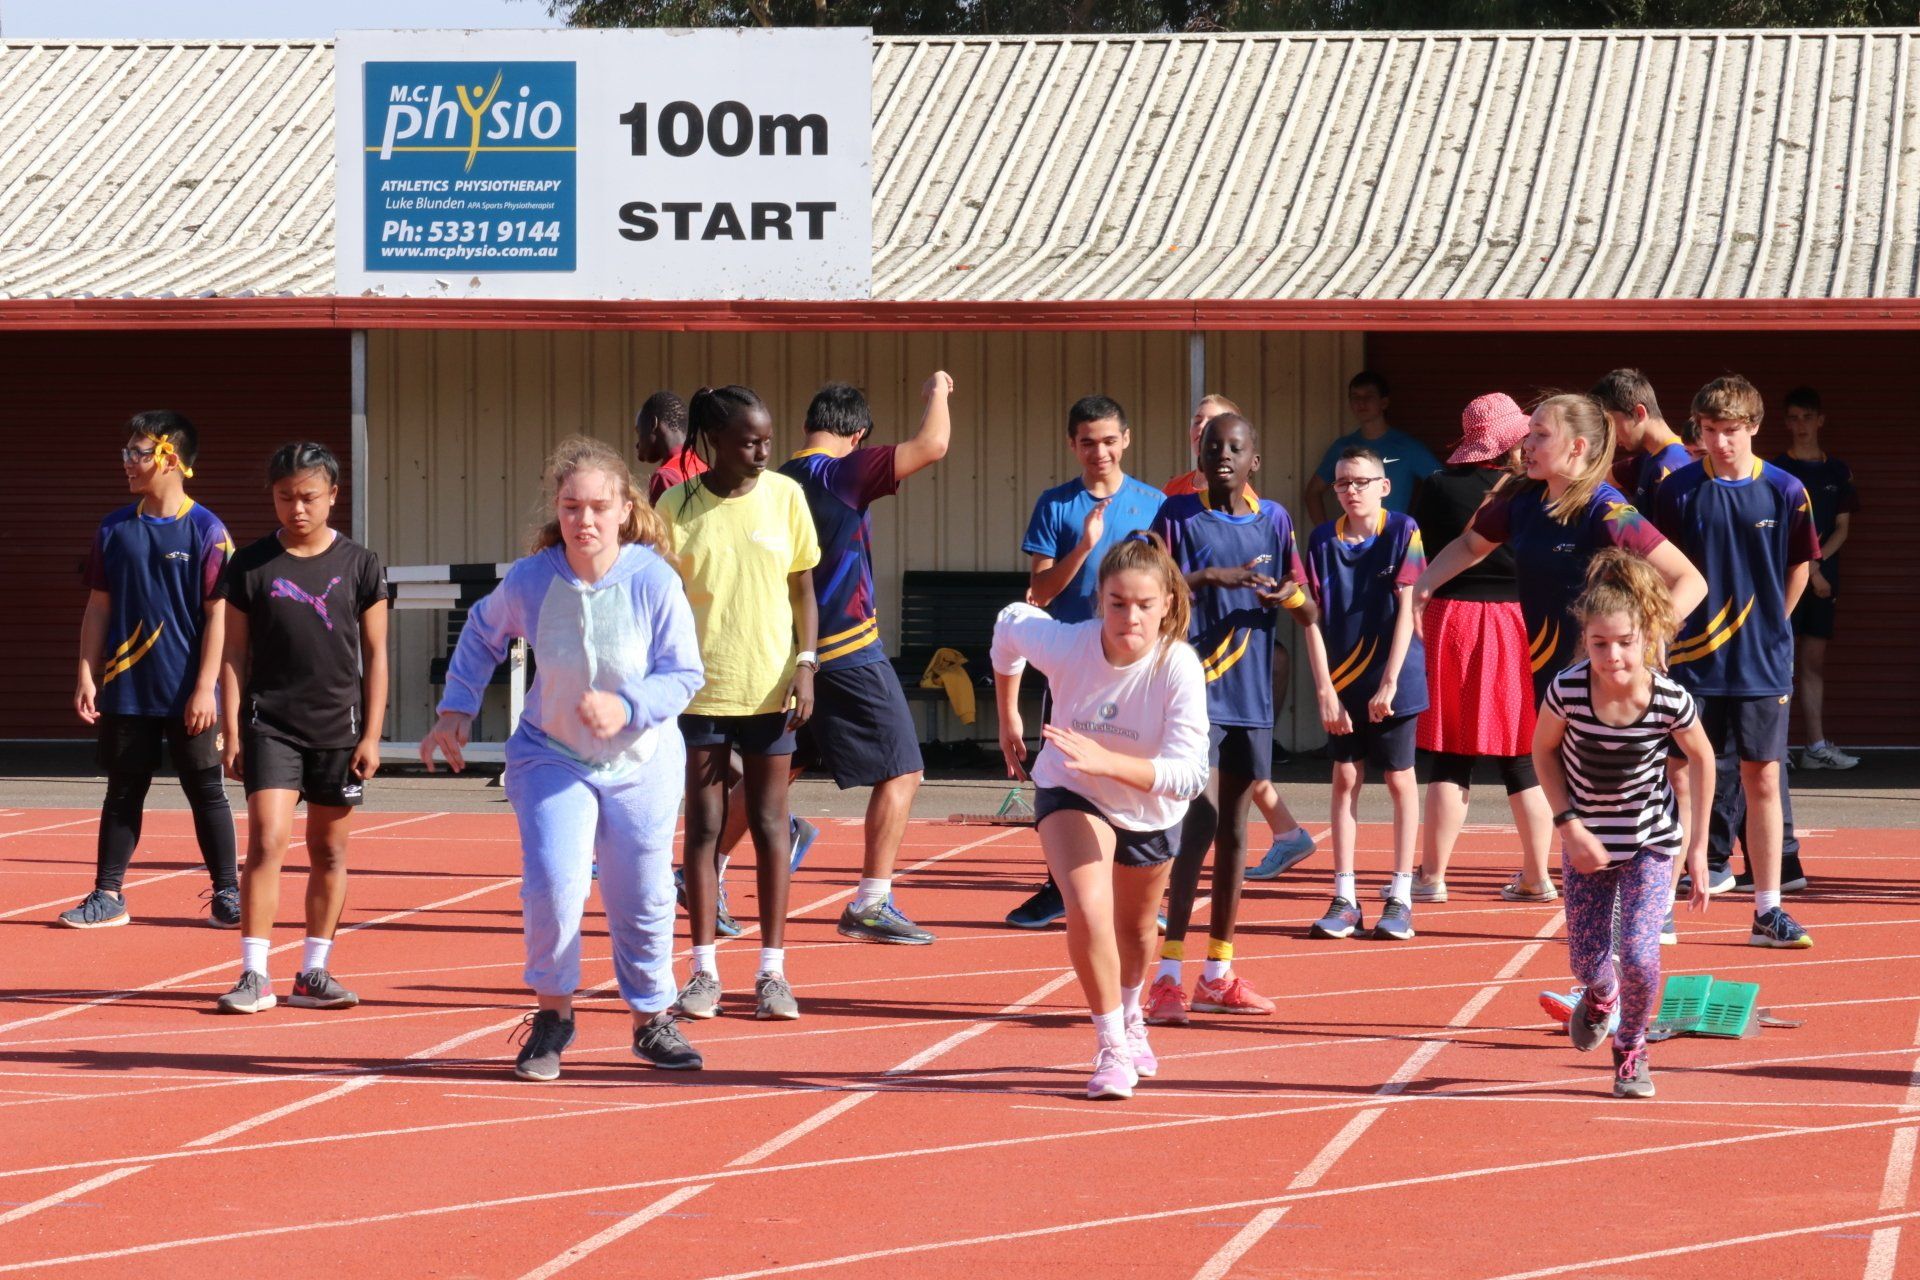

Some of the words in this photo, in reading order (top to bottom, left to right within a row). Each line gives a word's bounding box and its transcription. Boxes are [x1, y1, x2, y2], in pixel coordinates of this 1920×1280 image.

[390, 85, 429, 103] M.C.
[380, 68, 562, 174] physio
[619, 100, 829, 158] 100m
[381, 180, 449, 192] ATHLETICS
[454, 180, 562, 192] PHYSIOTHERAPY
[385, 197, 413, 209] Luke
[415, 197, 465, 209] Blunden
[467, 201, 481, 209] APA
[482, 201, 503, 210] Sports
[503, 201, 555, 211] Physiotherapist
[381, 220, 423, 242] Ph:
[427, 221, 489, 242] 5331
[497, 221, 560, 242] 9144
[618, 201, 837, 242] START
[381, 244, 558, 260] www.mcphysio.com.au
